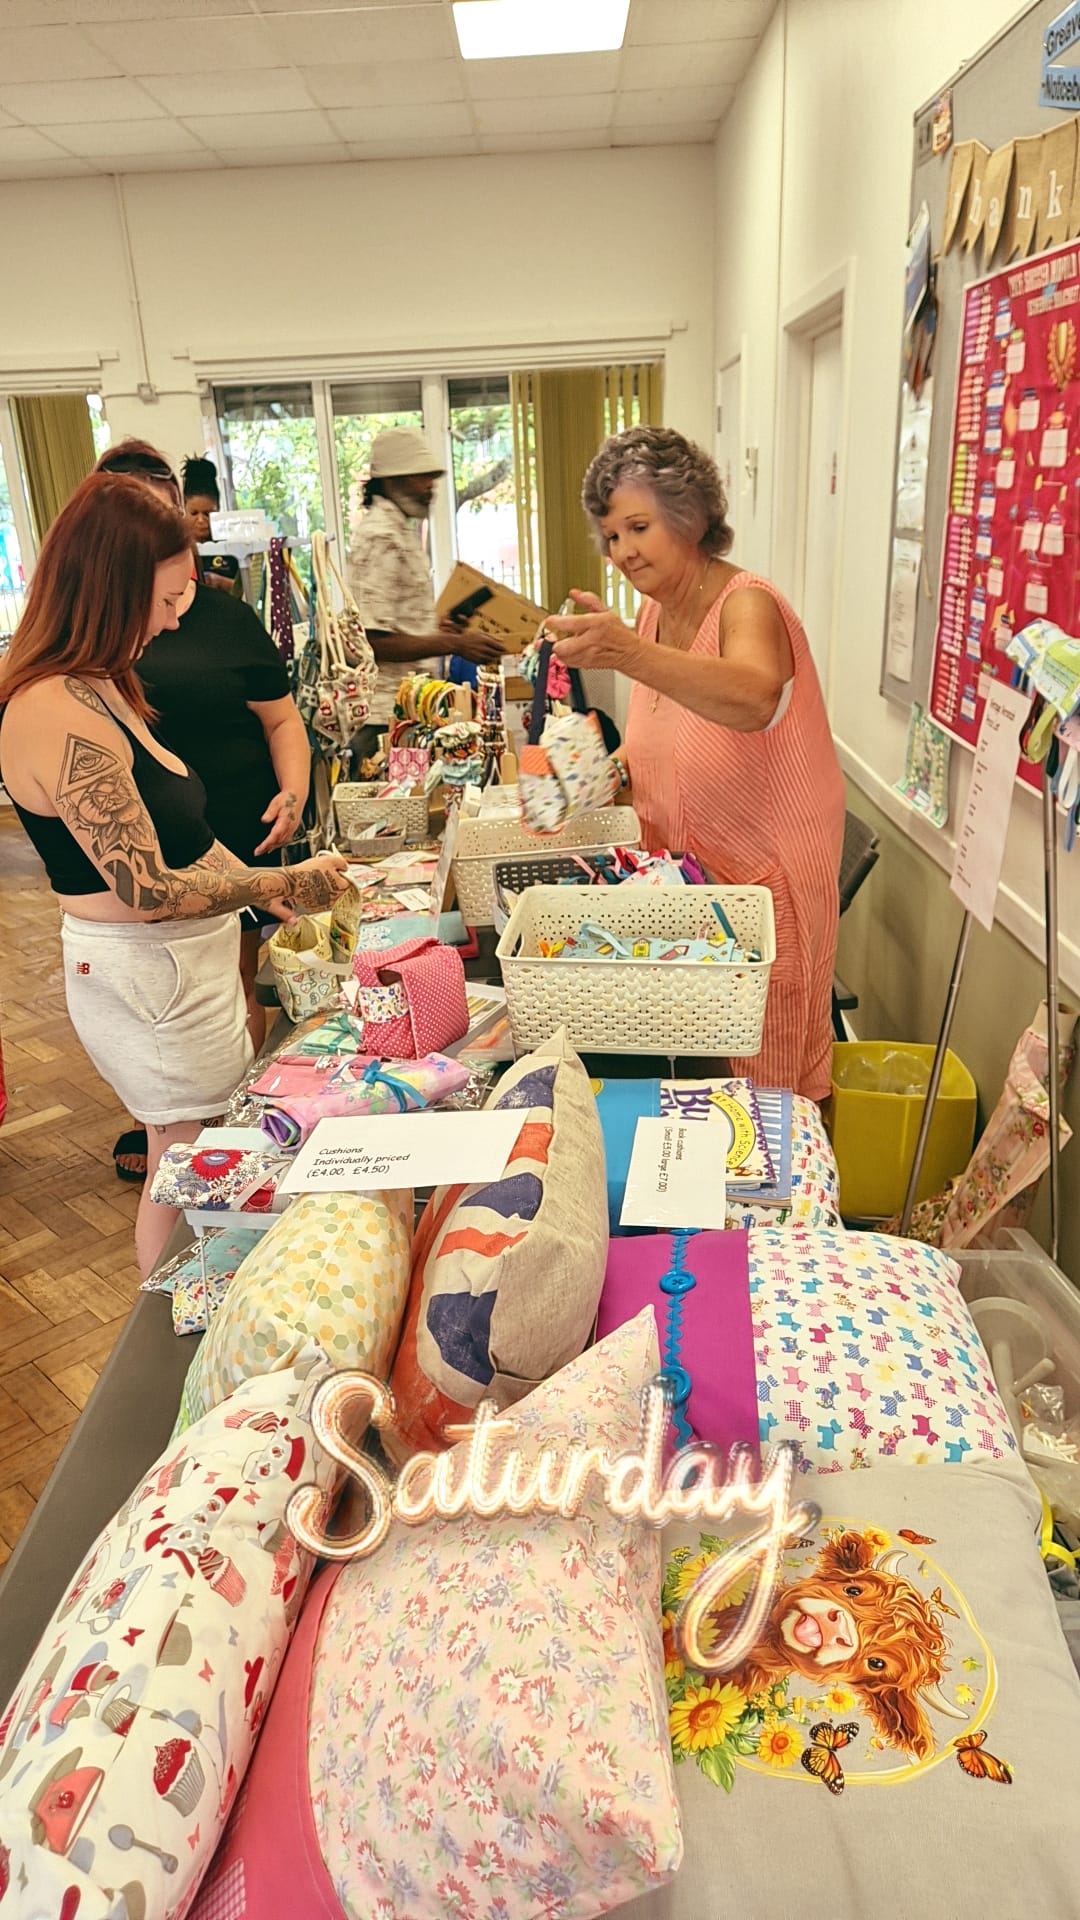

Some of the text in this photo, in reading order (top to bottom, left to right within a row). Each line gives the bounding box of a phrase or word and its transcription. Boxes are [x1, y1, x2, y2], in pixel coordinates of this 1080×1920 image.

[1044, 74, 1080, 101] Noticeb
[739, 1124, 752, 1138] with
[319, 1147, 364, 1155] Cushions
[675, 1140, 686, 1160] cushions
[725, 1140, 750, 1166] Science
[313, 1153, 410, 1166] Individually priced
[658, 1158, 670, 1171] large
[306, 1164, 391, 1178] (£4.00, £4.50)
